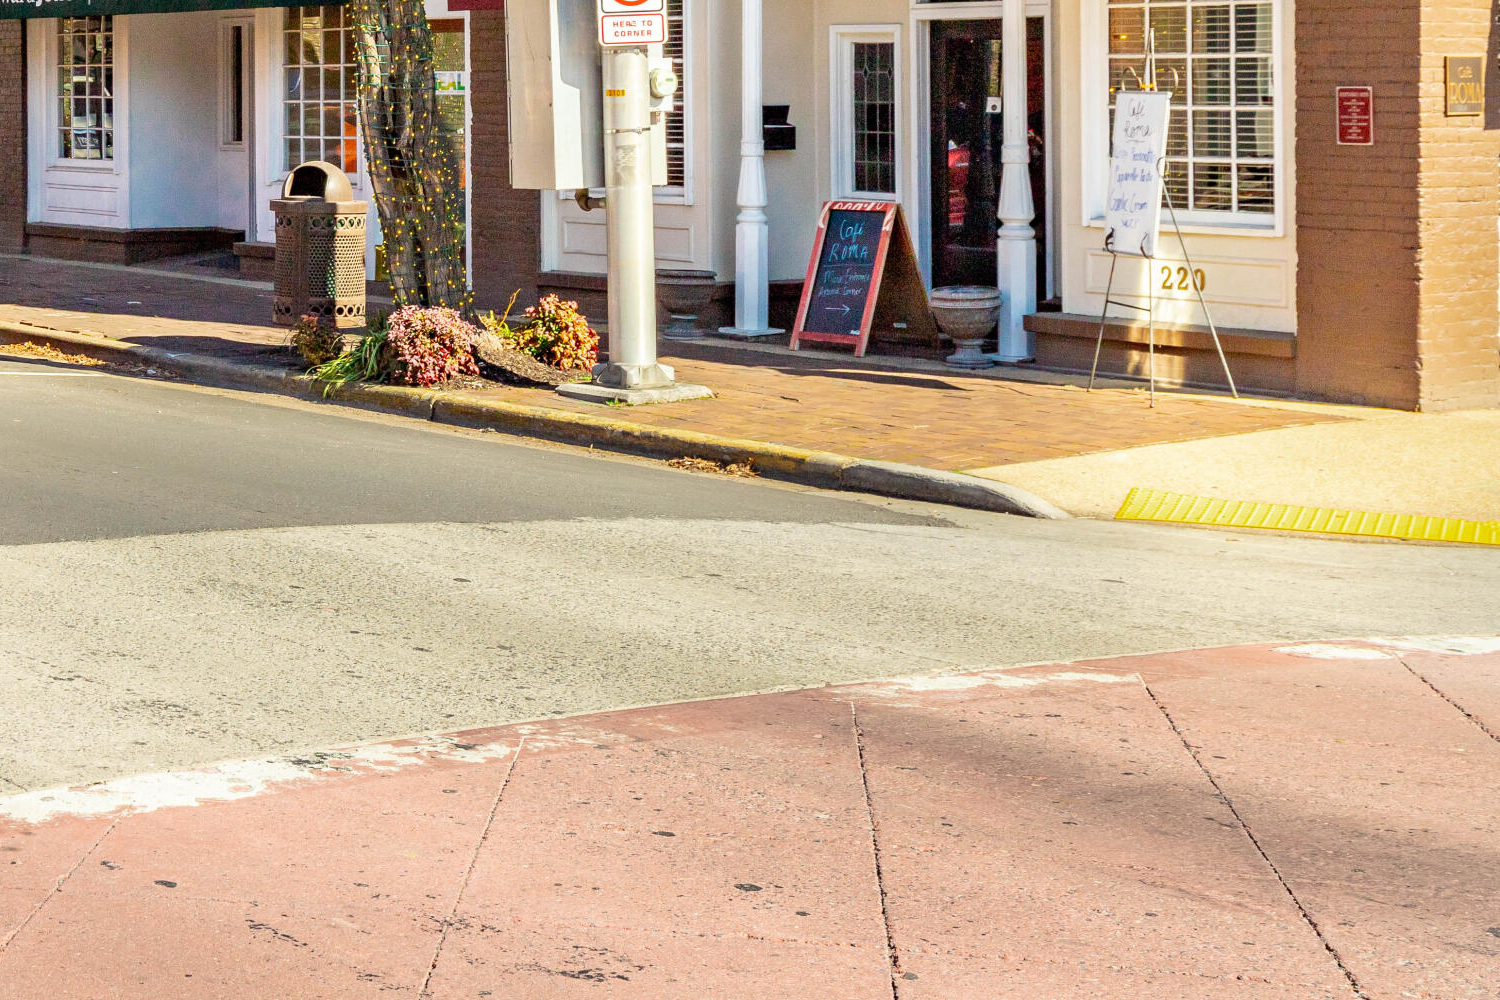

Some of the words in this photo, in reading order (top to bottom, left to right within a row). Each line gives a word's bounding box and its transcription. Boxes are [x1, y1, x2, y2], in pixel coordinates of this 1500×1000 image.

[612, 20, 637, 28] HERE
[641, 19, 653, 27] TO
[614, 29, 653, 38] CORNER
[828, 242, 868, 262] ROMA
[1160, 265, 1206, 293] 220
